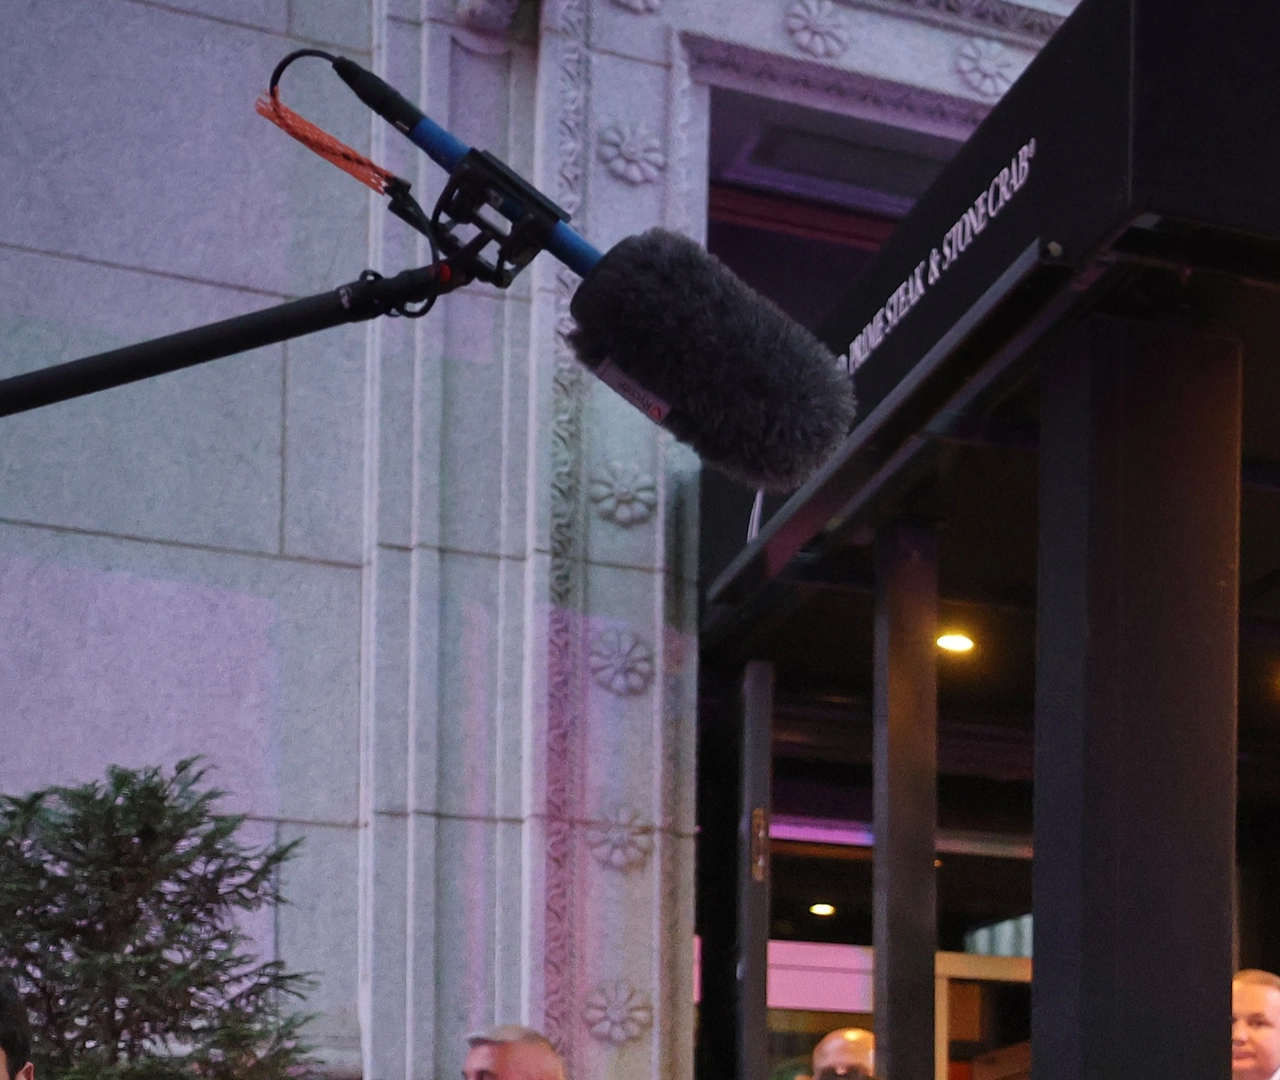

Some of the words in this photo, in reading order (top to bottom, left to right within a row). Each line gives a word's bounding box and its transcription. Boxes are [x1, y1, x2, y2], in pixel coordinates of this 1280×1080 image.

[884, 260, 926, 334] STEAK
[928, 248, 940, 285] &
[942, 190, 988, 270] STONE
